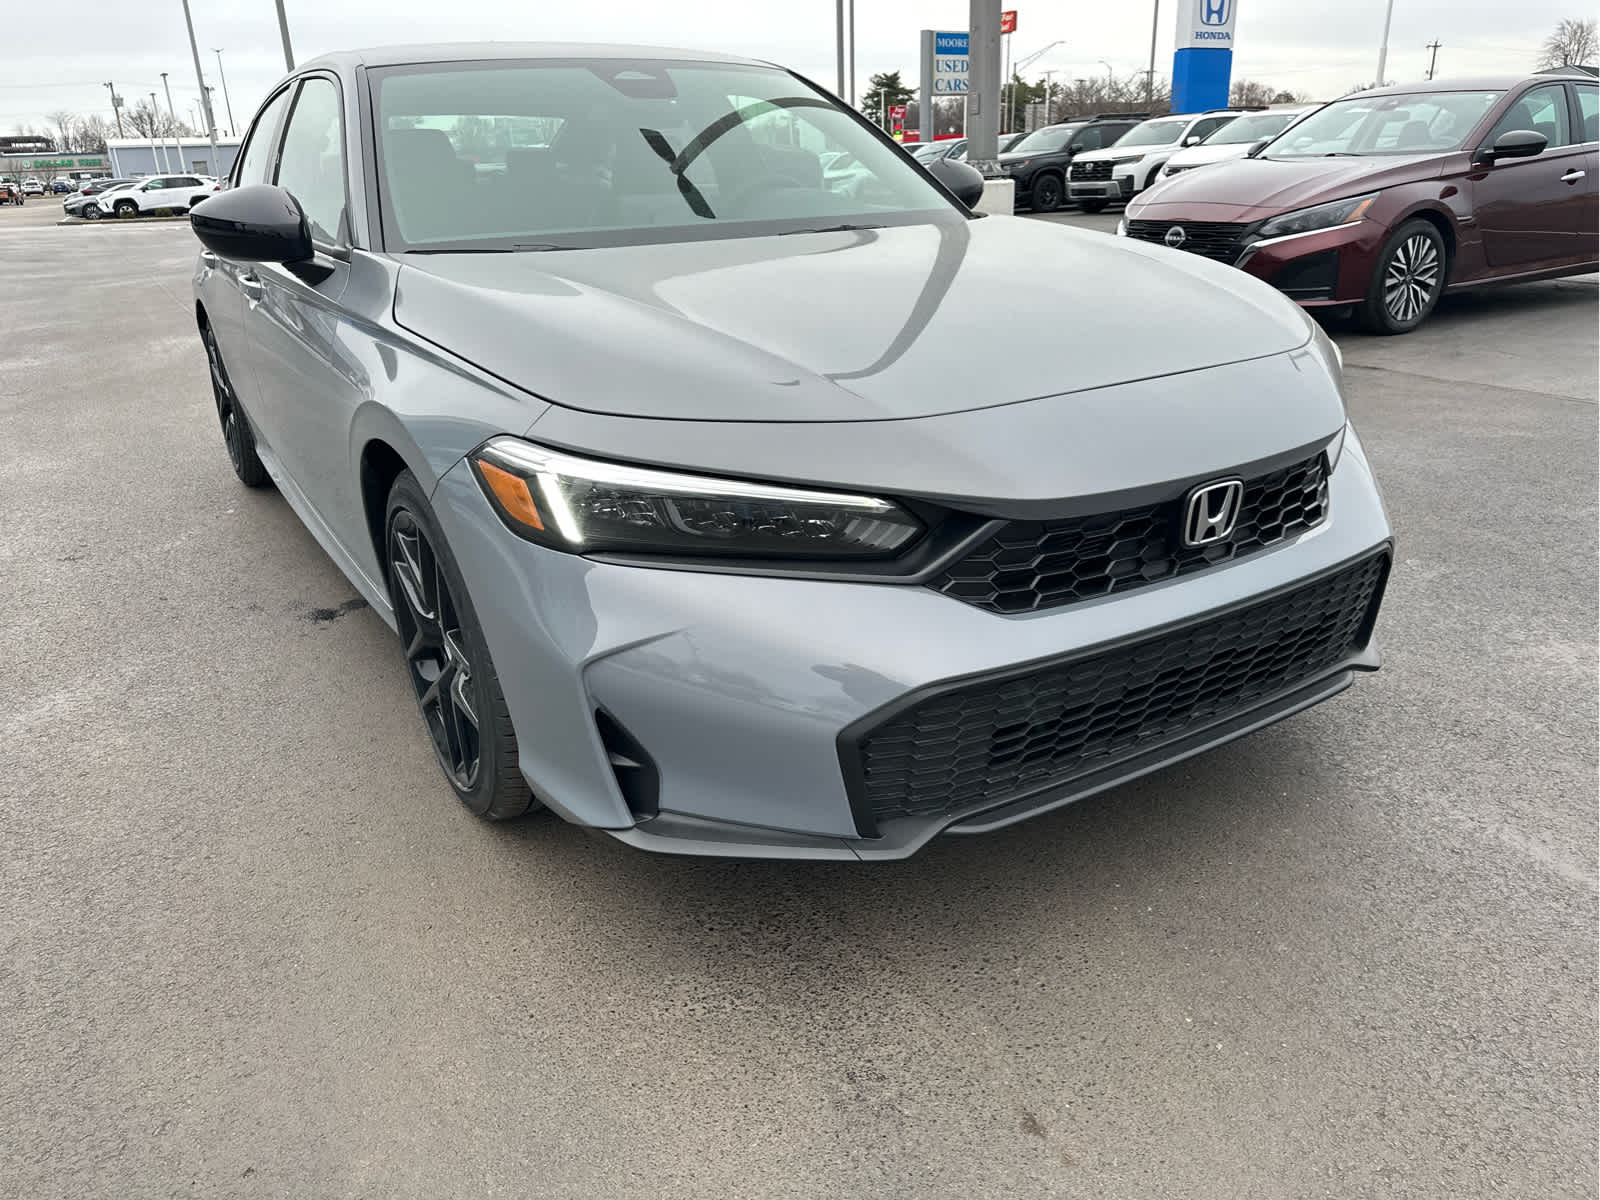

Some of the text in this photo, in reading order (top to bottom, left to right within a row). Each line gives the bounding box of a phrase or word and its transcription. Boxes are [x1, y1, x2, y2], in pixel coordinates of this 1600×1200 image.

[1195, 31, 1231, 40] HONDA
[936, 38, 969, 48] MOORE
[936, 59, 969, 73] USED
[935, 78, 969, 92] CARS
[33, 159, 73, 169] DOLLAR
